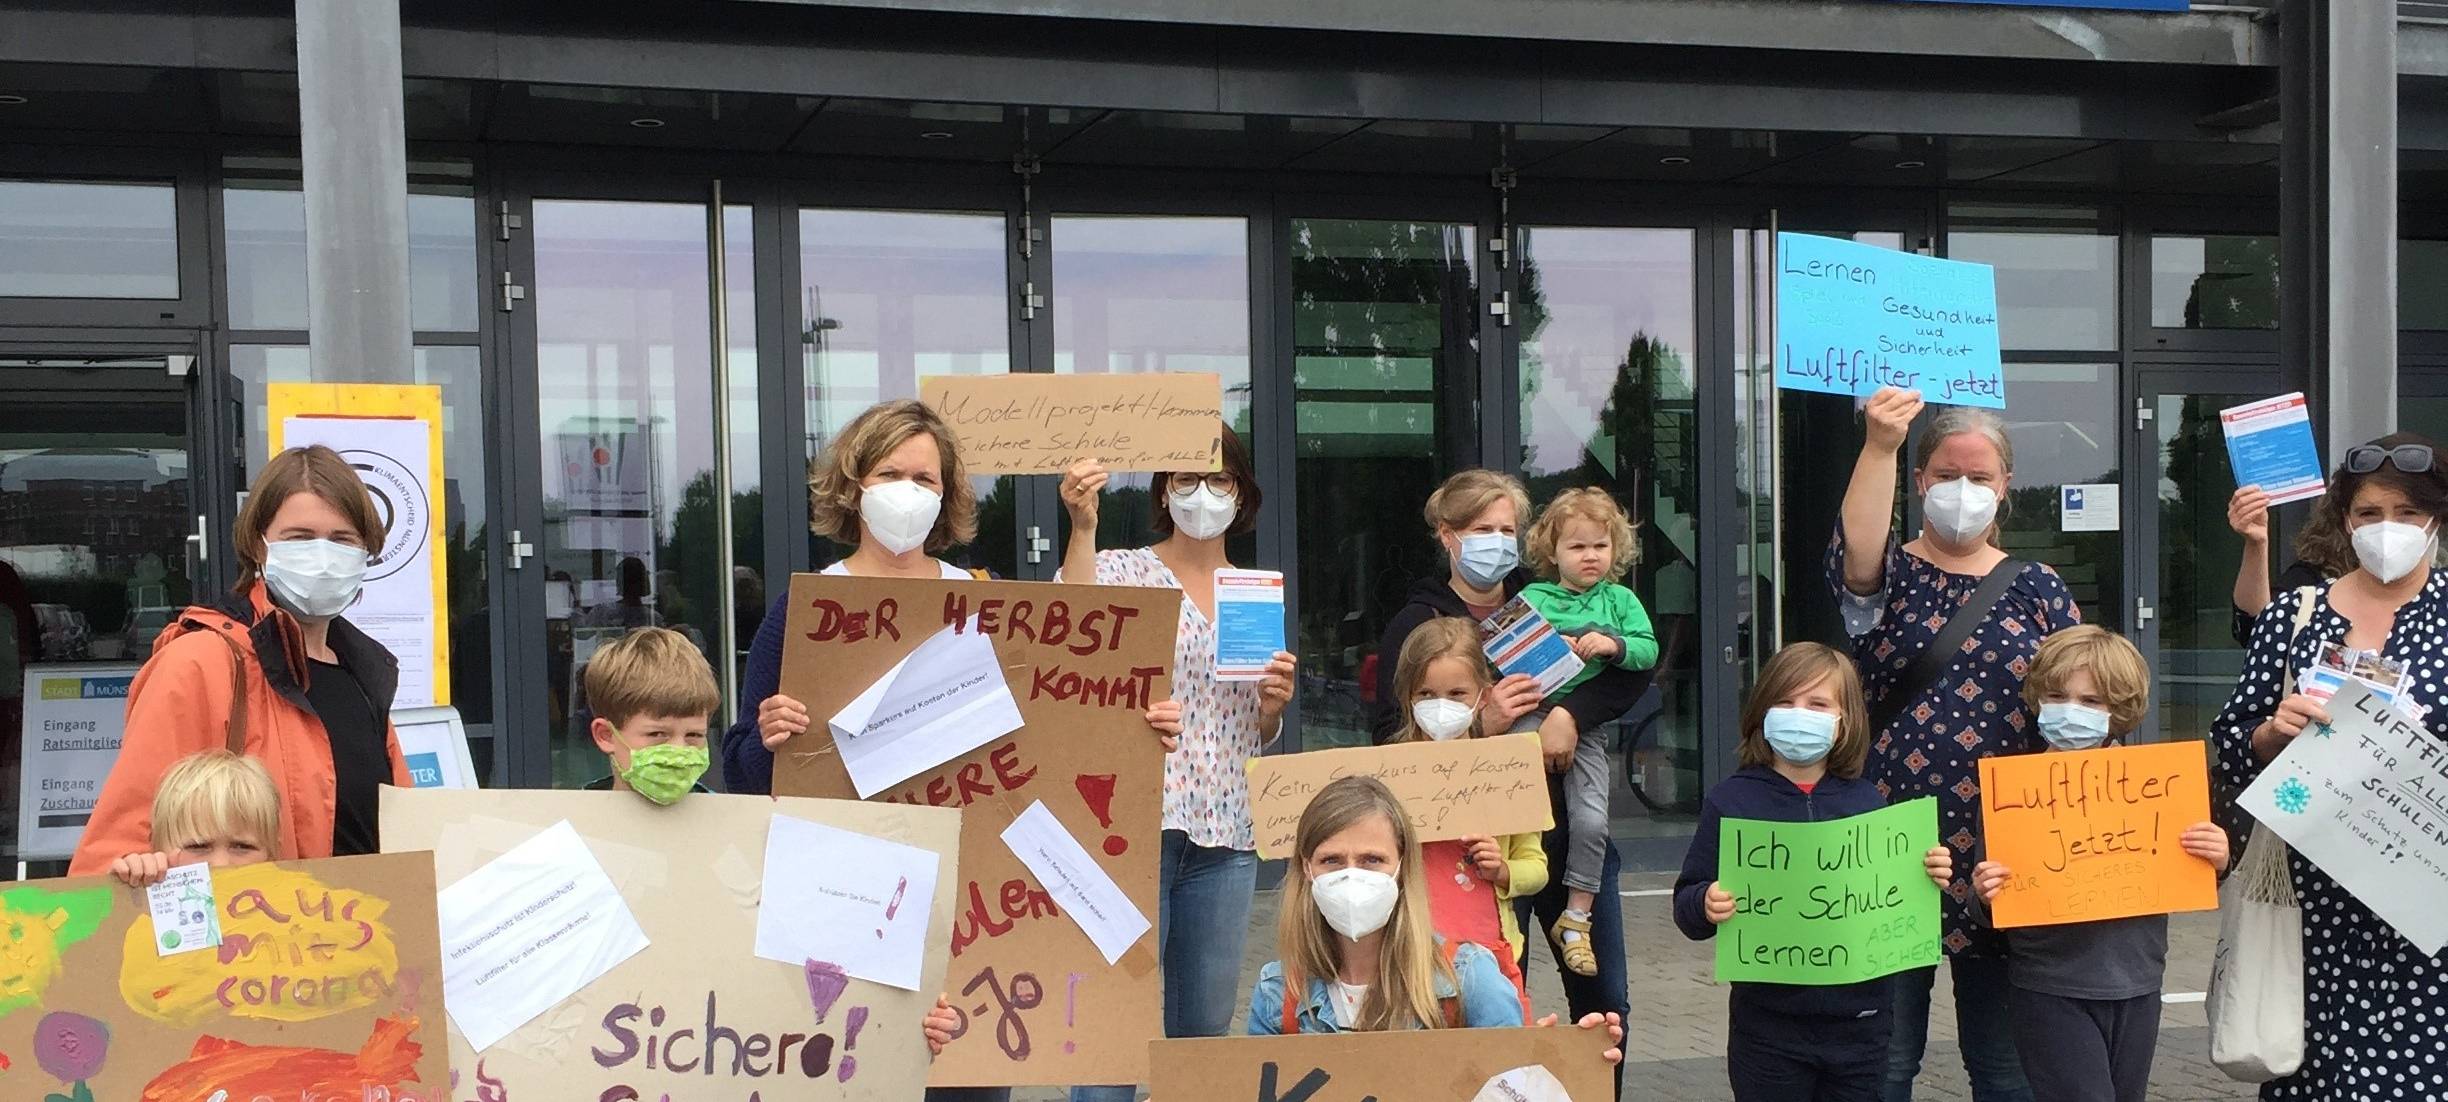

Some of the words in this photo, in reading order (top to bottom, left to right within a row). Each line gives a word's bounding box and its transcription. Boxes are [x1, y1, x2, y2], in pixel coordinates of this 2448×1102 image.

[1784, 239, 1876, 285] Lernen
[1882, 296, 1996, 325] Gesundheit
[1915, 327, 1945, 338] und
[1877, 334, 1974, 357] Sicherheit
[1785, 343, 1921, 394] Luftfilter
[1940, 369, 2004, 400] jetzt
[1038, 430, 1132, 451] Schule
[942, 591, 1140, 656] HERBST
[96, 684, 130, 697] MÜNS
[1029, 664, 1165, 710] KOMMT
[43, 719, 97, 733] Eingang
[41, 778, 94, 792] Eingang
[1258, 770, 1317, 801] Kein
[1469, 755, 1530, 776] Kosten
[1990, 759, 2181, 820] Luftfilter
[2358, 733, 2398, 772] FÜR
[2404, 775, 2448, 815] ALL
[2361, 778, 2448, 847] SCHULEN
[1736, 829, 1790, 870] Ich
[1817, 824, 1872, 872] will
[1886, 826, 1909, 858] in
[226, 888, 374, 951] aus
[951, 879, 1059, 958] ulen
[1734, 883, 1784, 915] der
[1798, 873, 1904, 920] Schule
[217, 923, 339, 968] mit
[1865, 915, 1919, 948] ABER
[216, 966, 393, 1008] corona
